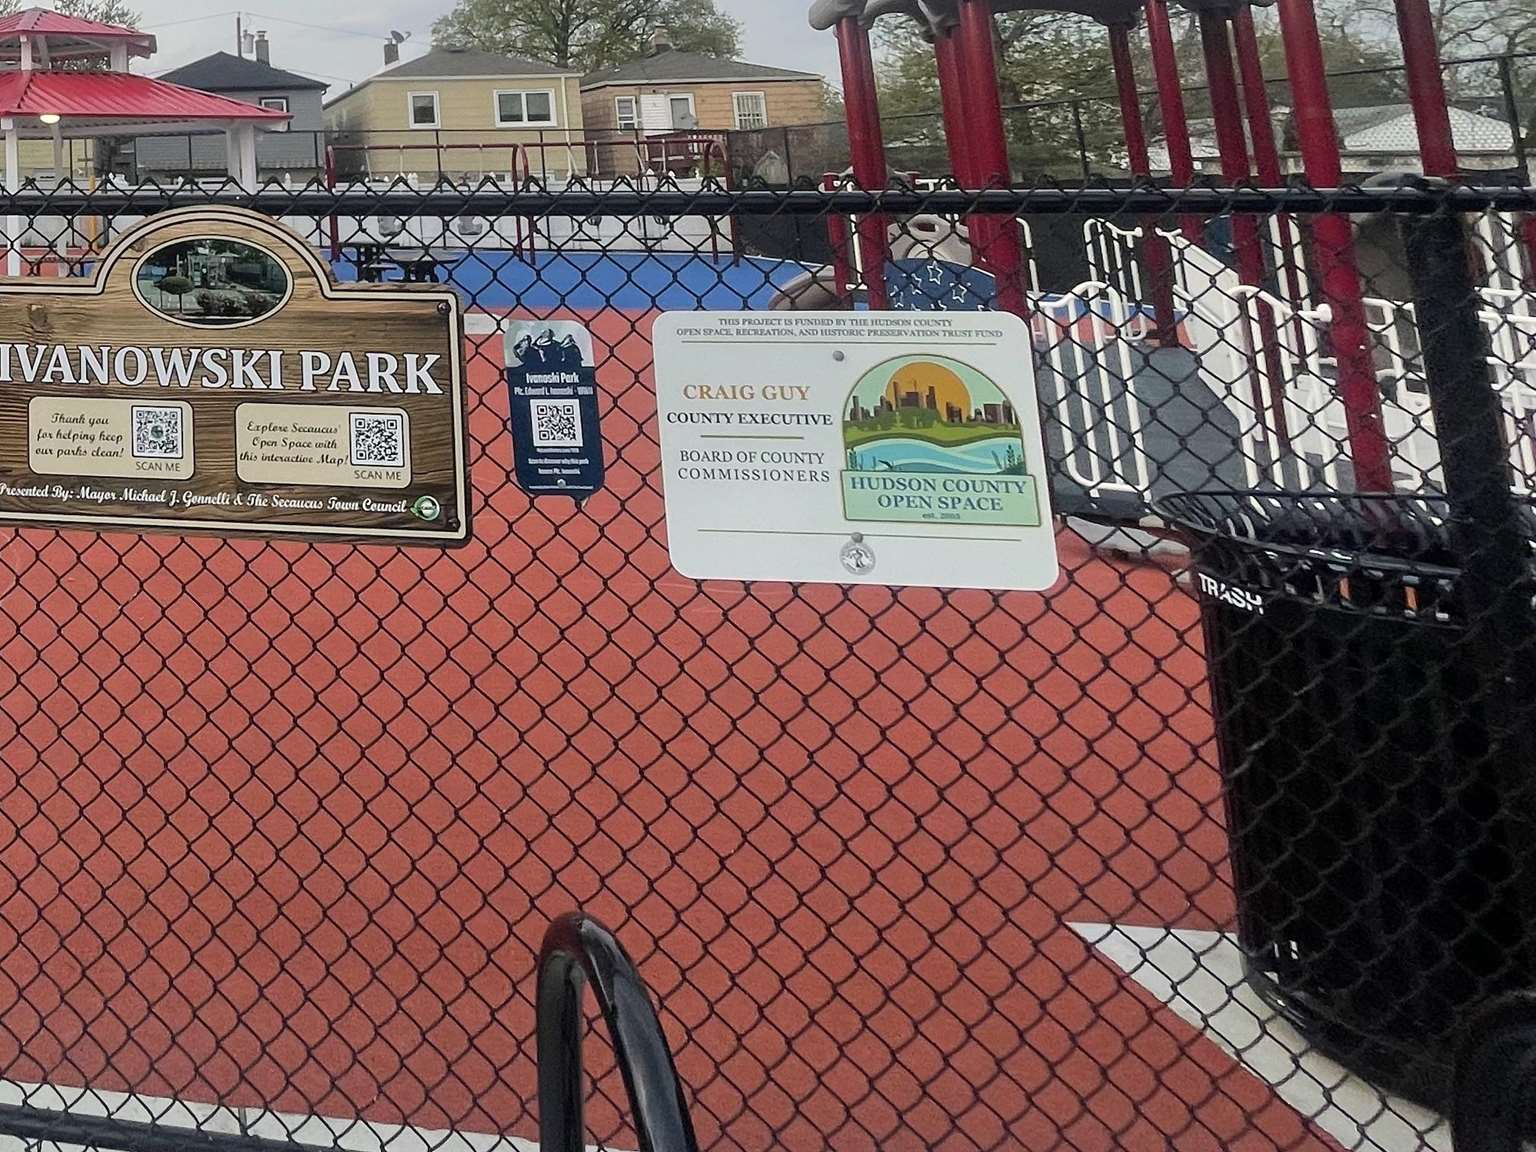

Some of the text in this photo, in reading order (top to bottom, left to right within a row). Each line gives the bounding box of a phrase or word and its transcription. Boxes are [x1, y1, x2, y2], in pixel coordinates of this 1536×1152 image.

[719, 318, 952, 326] THIS PROJECT IS FUNDED BY THE HUDSON COUNTY
[676, 329, 701, 337] OPEN
[736, 329, 797, 337] RECREATION,
[798, 329, 818, 337] AND
[820, 329, 866, 337] HISTORIC
[867, 329, 940, 337] PRESERVATION
[941, 329, 973, 337] TRUST
[975, 329, 1003, 337] FUND
[299, 350, 444, 394] PARK
[560, 372, 579, 383] Park
[683, 384, 811, 400] CRAIG GUY
[51, 412, 109, 428] Thank you
[667, 412, 833, 425] COUNTY EXECUTIVE
[246, 421, 288, 434] Explore
[37, 429, 124, 444] for helping keep
[252, 436, 337, 451] Open Space with
[35, 447, 125, 458] our parks clean!
[239, 451, 348, 468] this interactive Map!
[680, 450, 825, 465] BOARD OF COUNTY
[135, 461, 181, 472] SCAN ME
[354, 469, 401, 481] SCAN ME
[678, 468, 830, 483] COMMISSIONERS
[851, 476, 1027, 494] HUDSON COUNTY
[51, 484, 74, 502] By:
[76, 486, 116, 503] Mayor
[119, 488, 166, 504] Michael
[169, 490, 180, 505] J.
[182, 490, 230, 507] Gonnelli
[233, 492, 244, 505] &
[246, 493, 268, 507] The
[270, 494, 324, 509] Secaucus
[326, 497, 360, 511] Town
[362, 498, 407, 513] Council
[878, 495, 1004, 511] OPEN SPACE
[1198, 572, 1264, 615] TRASH
